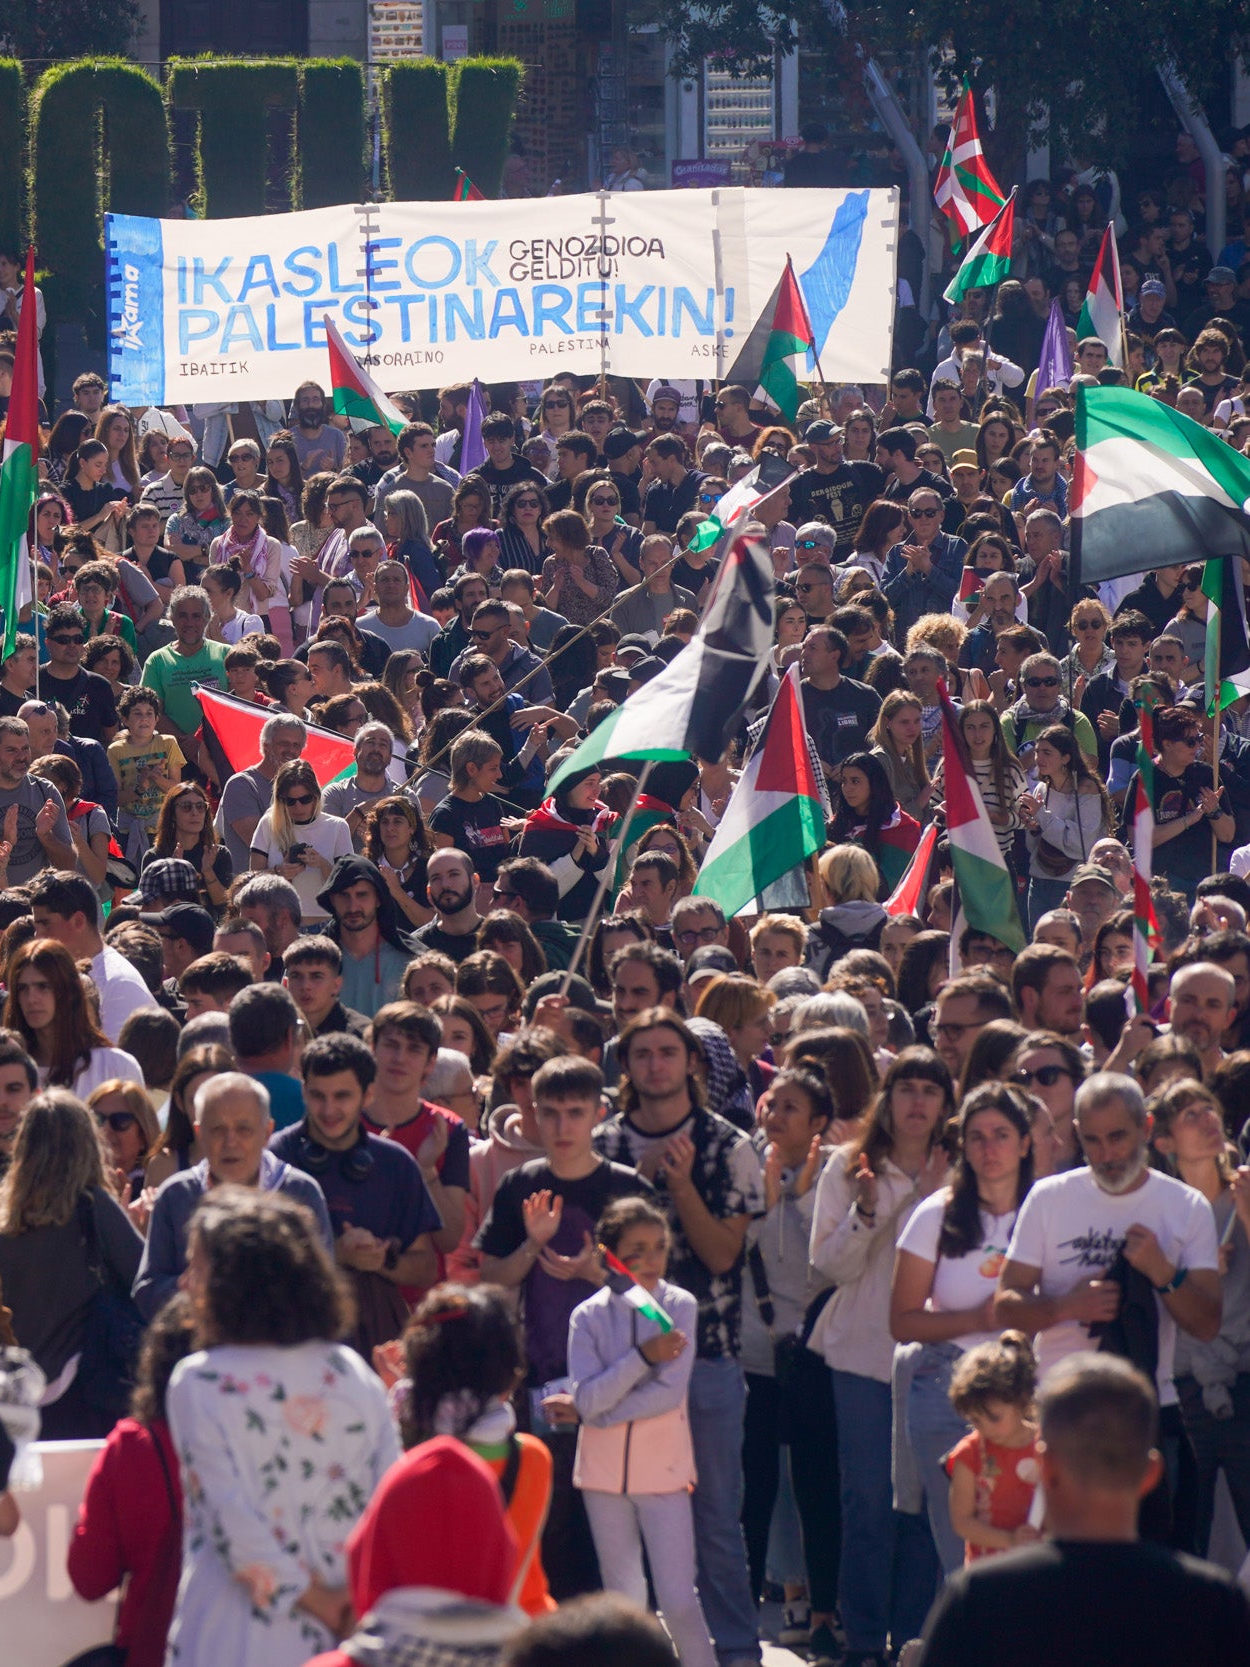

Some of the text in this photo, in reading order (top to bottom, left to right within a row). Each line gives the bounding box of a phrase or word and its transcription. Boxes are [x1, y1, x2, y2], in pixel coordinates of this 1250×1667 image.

[509, 235, 665, 259] GENOZIDIOA
[177, 235, 501, 305] IKASLEOK
[509, 257, 618, 282] GELDITU!
[178, 282, 735, 355] PALESTINAREKIN!
[530, 338, 611, 355] PALESTINA
[691, 344, 730, 358] ASKE
[180, 361, 250, 377] IBAITIK
